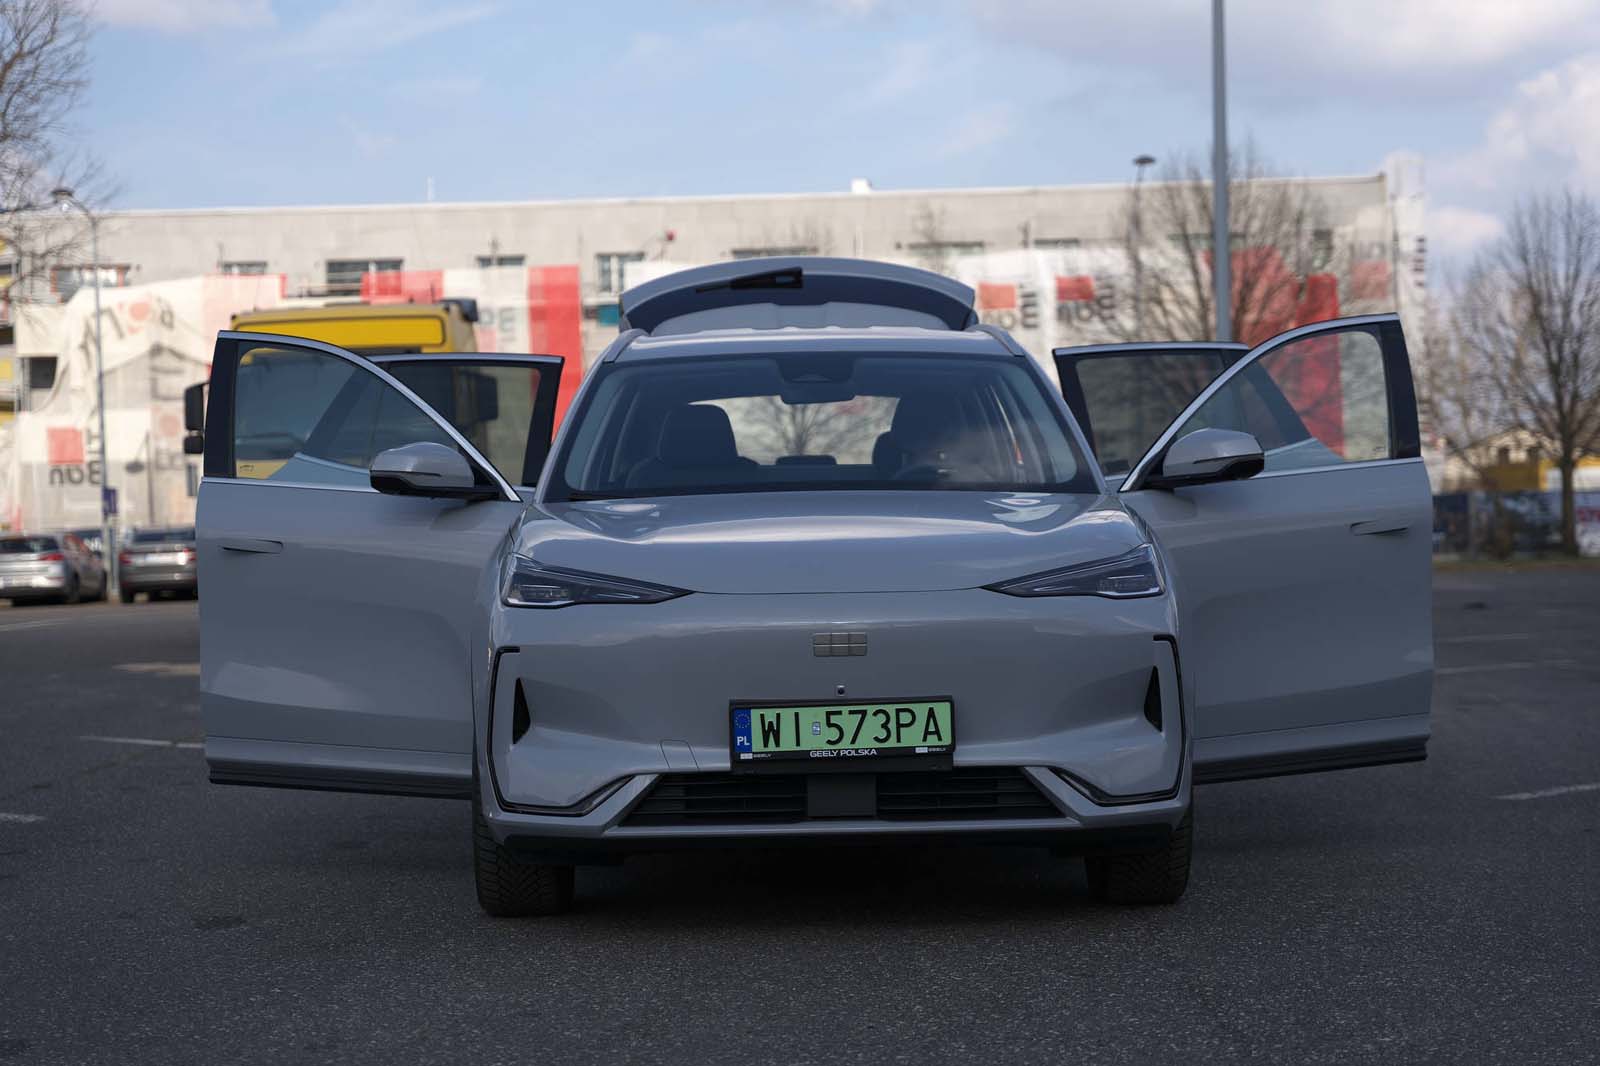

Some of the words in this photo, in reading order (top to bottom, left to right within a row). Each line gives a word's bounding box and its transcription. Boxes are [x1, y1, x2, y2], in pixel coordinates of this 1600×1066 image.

[760, 712, 800, 748] WI
[825, 707, 943, 745] 573PA
[737, 736, 750, 746] PL
[810, 749, 837, 758] GEELY
[840, 748, 877, 757] POLSKA
